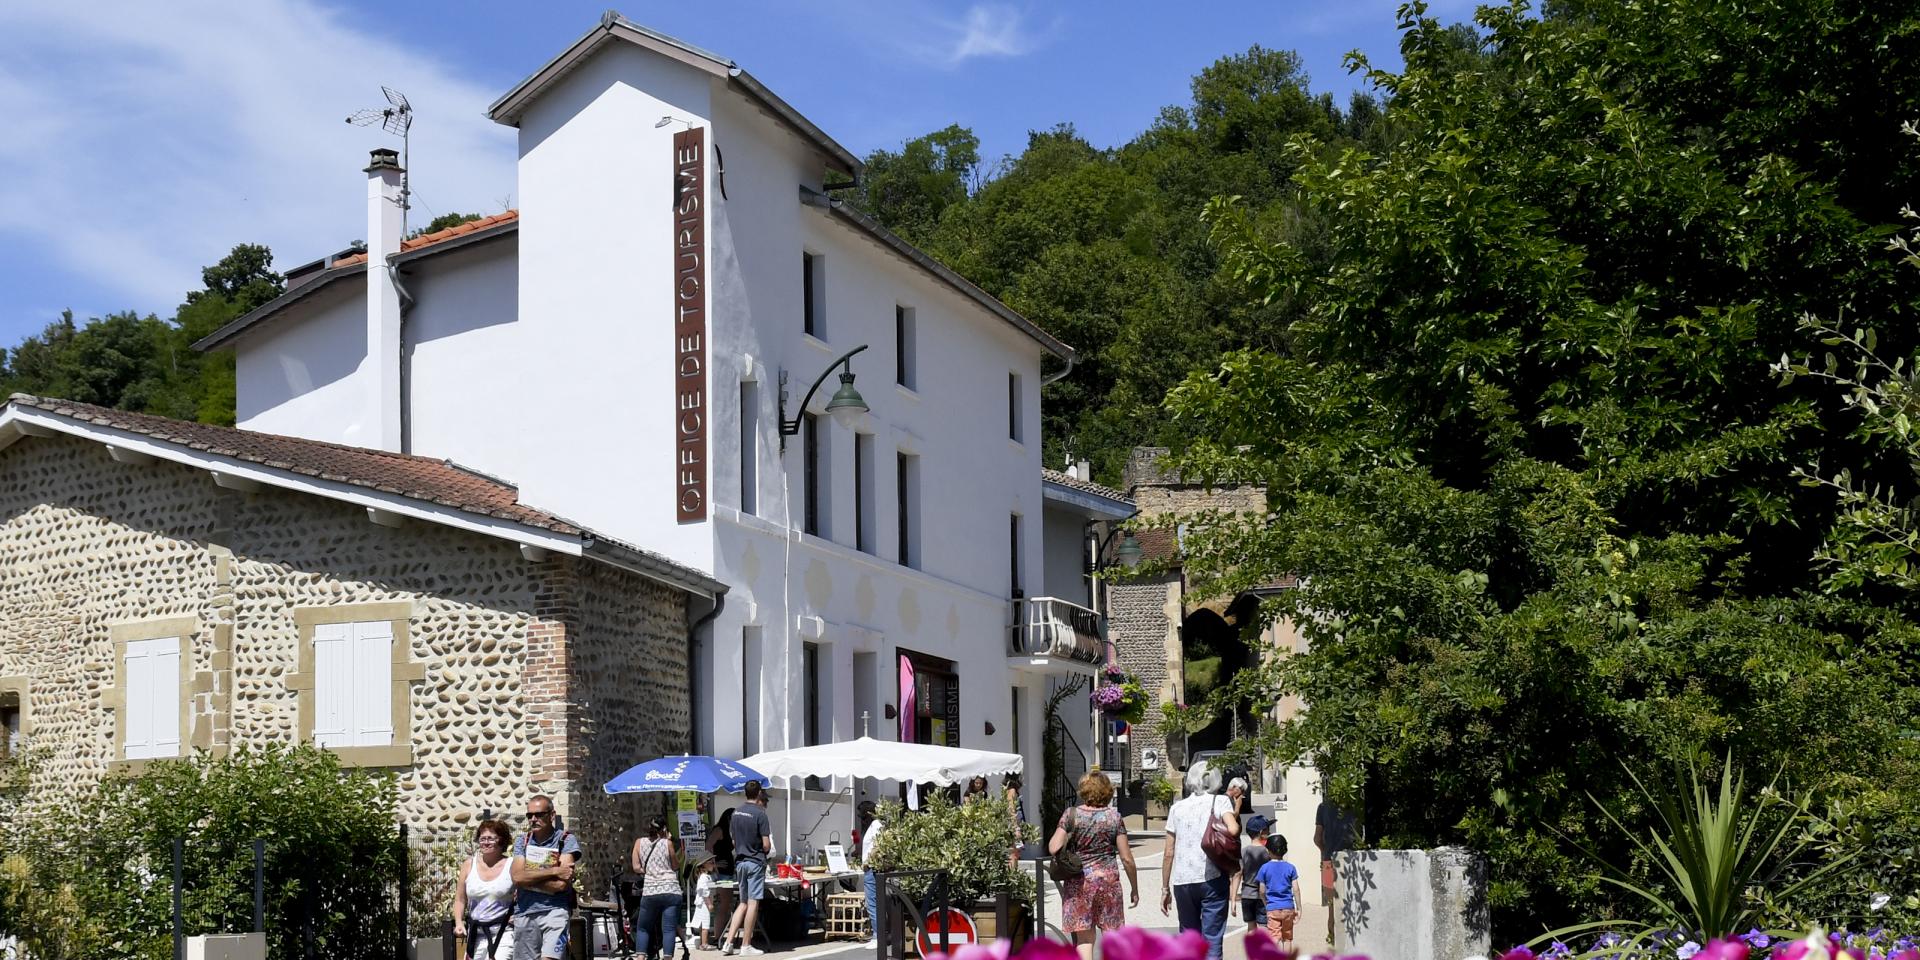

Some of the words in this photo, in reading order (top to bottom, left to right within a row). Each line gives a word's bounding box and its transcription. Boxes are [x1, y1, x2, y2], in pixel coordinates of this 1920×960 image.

[679, 142, 699, 323] TOURISME
[680, 331, 700, 376] DE
[681, 388, 701, 512] OFFICE
[947, 678, 958, 747] URISME
